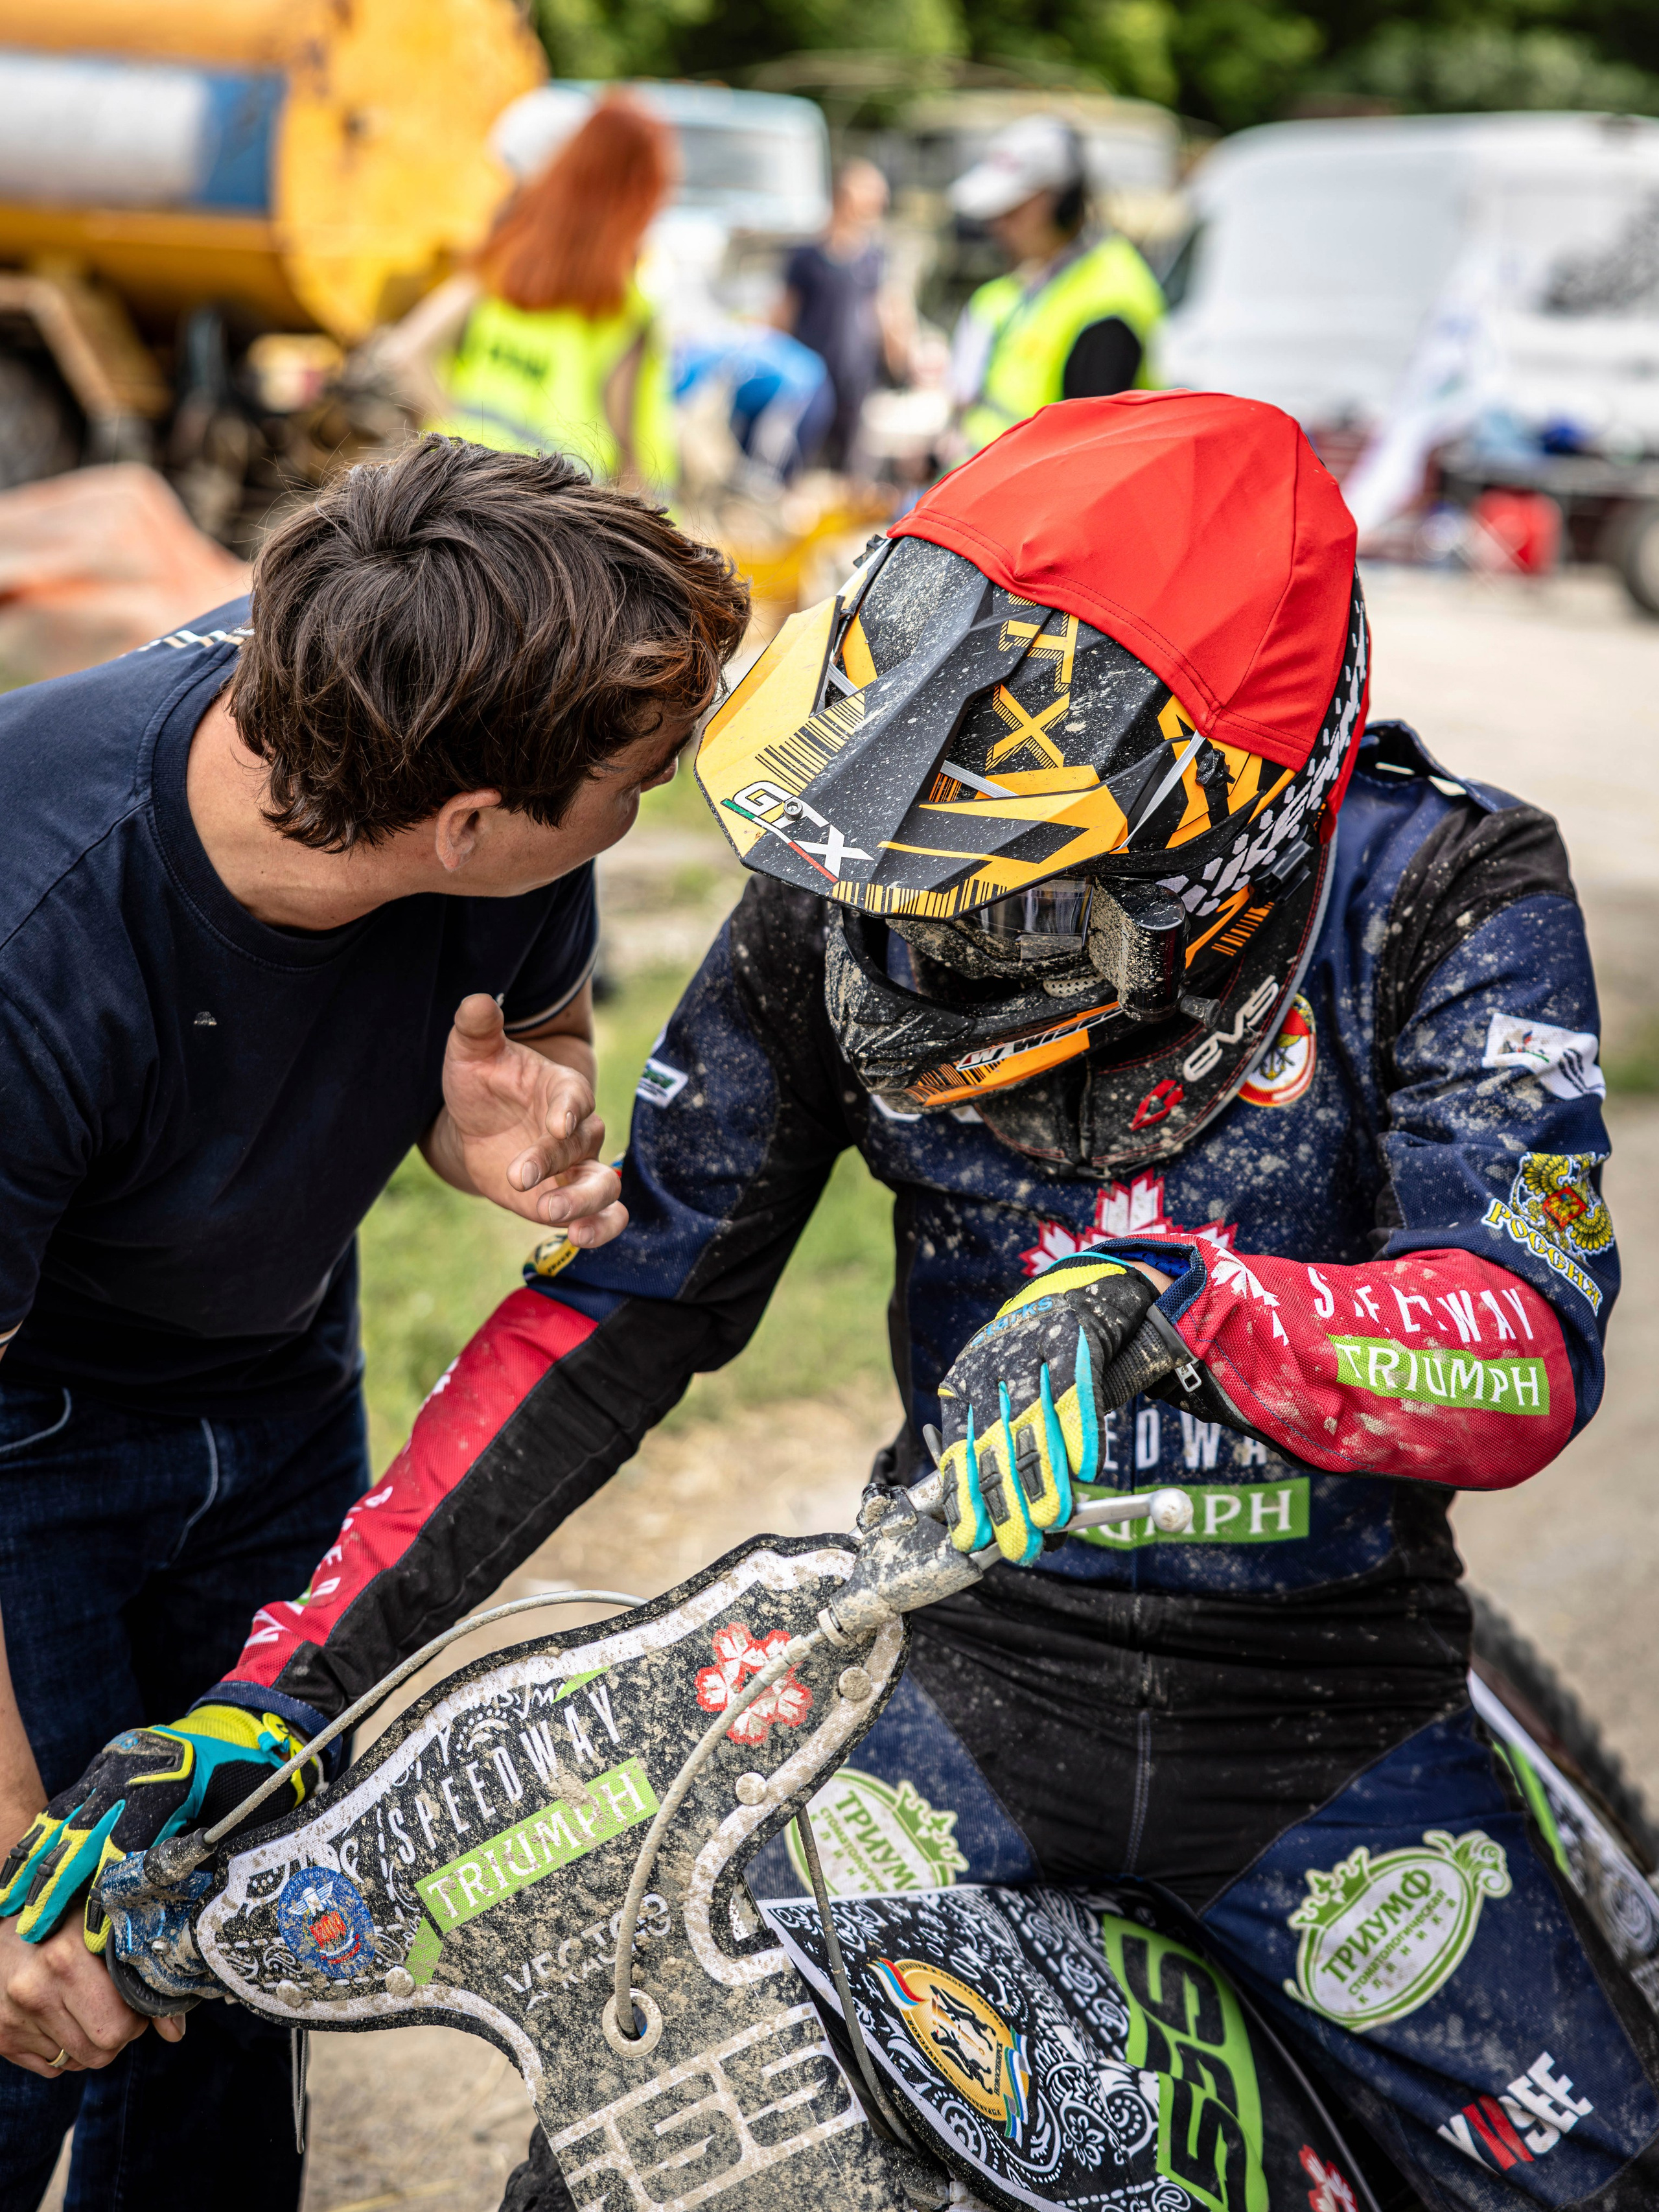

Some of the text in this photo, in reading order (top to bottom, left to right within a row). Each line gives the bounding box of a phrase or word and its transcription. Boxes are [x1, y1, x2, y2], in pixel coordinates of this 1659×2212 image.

[733, 780, 874, 878] GTX
[1484, 1200, 1600, 1309] РОССИЯ
[1336, 1342, 1540, 1406] TRIUMPH
[388, 1685, 621, 1865] SPEEDWAY
[426, 1771, 646, 1919] TRIUMPH
[835, 1789, 923, 1890] ТРИУМ
[1321, 1869, 1432, 1983] ТРИУМФ
[940, 1971, 975, 1997] СПОРТА
